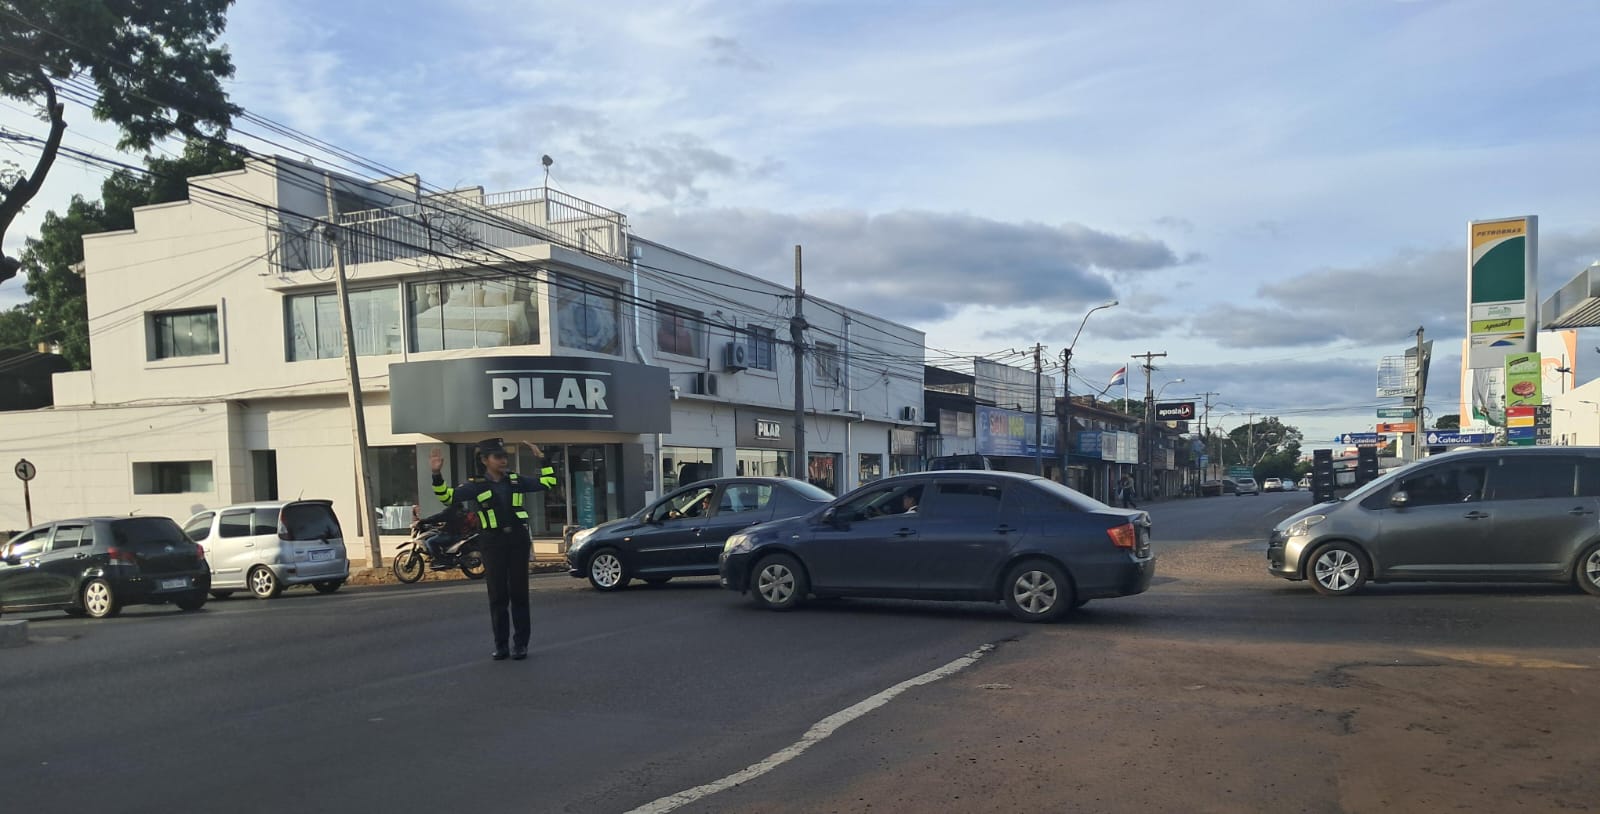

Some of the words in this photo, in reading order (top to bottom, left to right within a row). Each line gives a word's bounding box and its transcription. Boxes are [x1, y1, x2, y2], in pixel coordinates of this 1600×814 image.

[1476, 228, 1521, 237] PETROBRAS
[492, 377, 609, 410] PILAR
[758, 422, 780, 437] PILAR
[1438, 435, 1472, 444] Catedral
